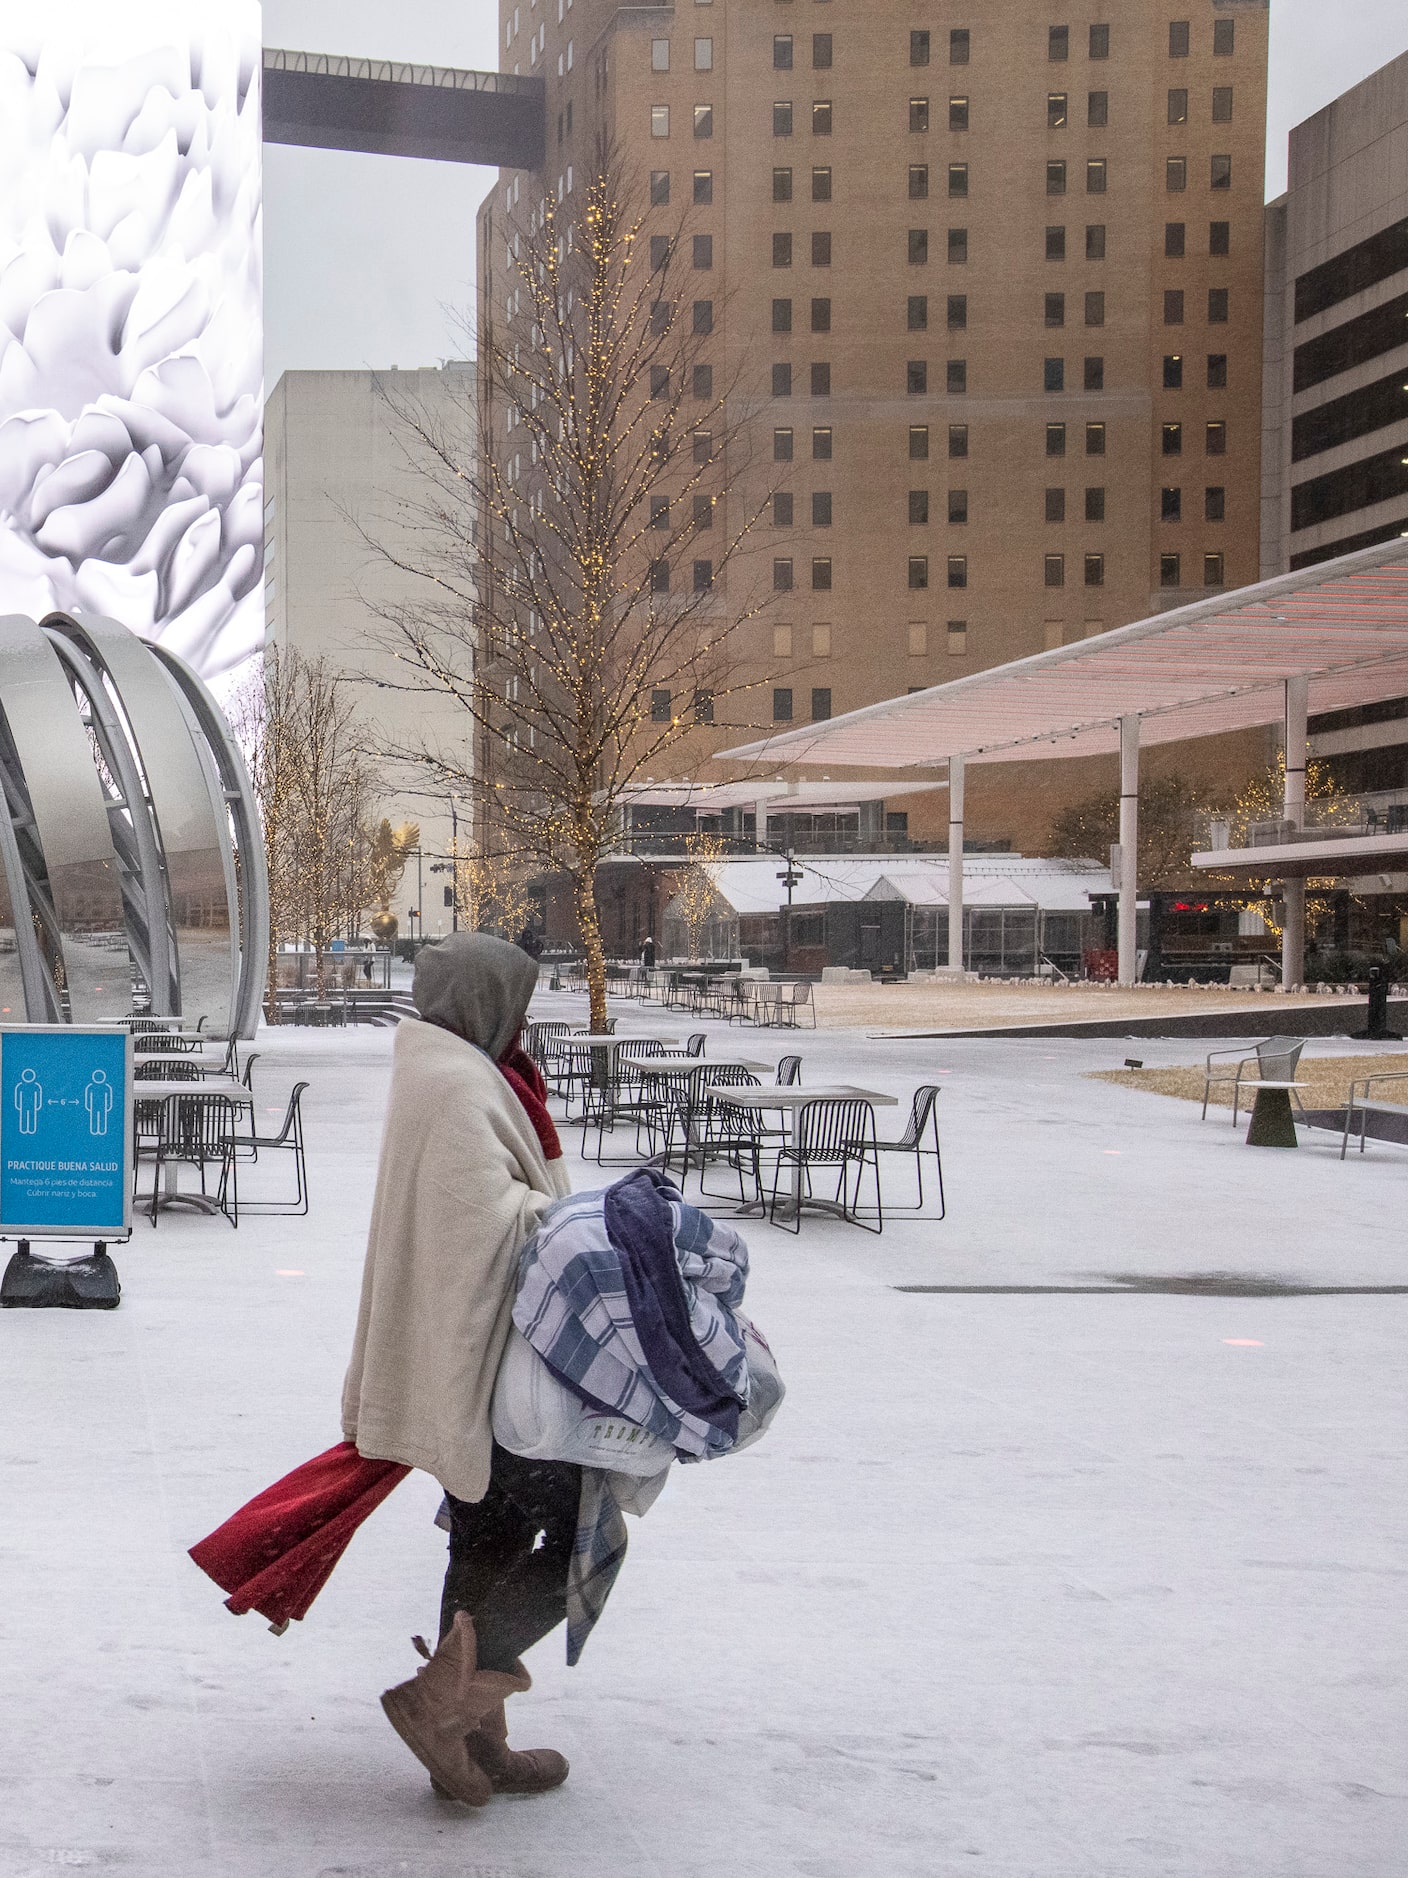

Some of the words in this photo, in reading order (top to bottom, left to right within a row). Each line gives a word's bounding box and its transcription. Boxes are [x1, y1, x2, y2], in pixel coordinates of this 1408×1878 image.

[7, 1160, 56, 1171] PRACTIQUE
[58, 1161, 88, 1171] BUENA
[89, 1162, 118, 1172] SALUD
[44, 1177, 51, 1186] 6
[51, 1178, 67, 1188] pies
[68, 1178, 78, 1187] de
[79, 1178, 113, 1187] distancia
[51, 1189, 70, 1198] nariz
[71, 1190, 76, 1199] y
